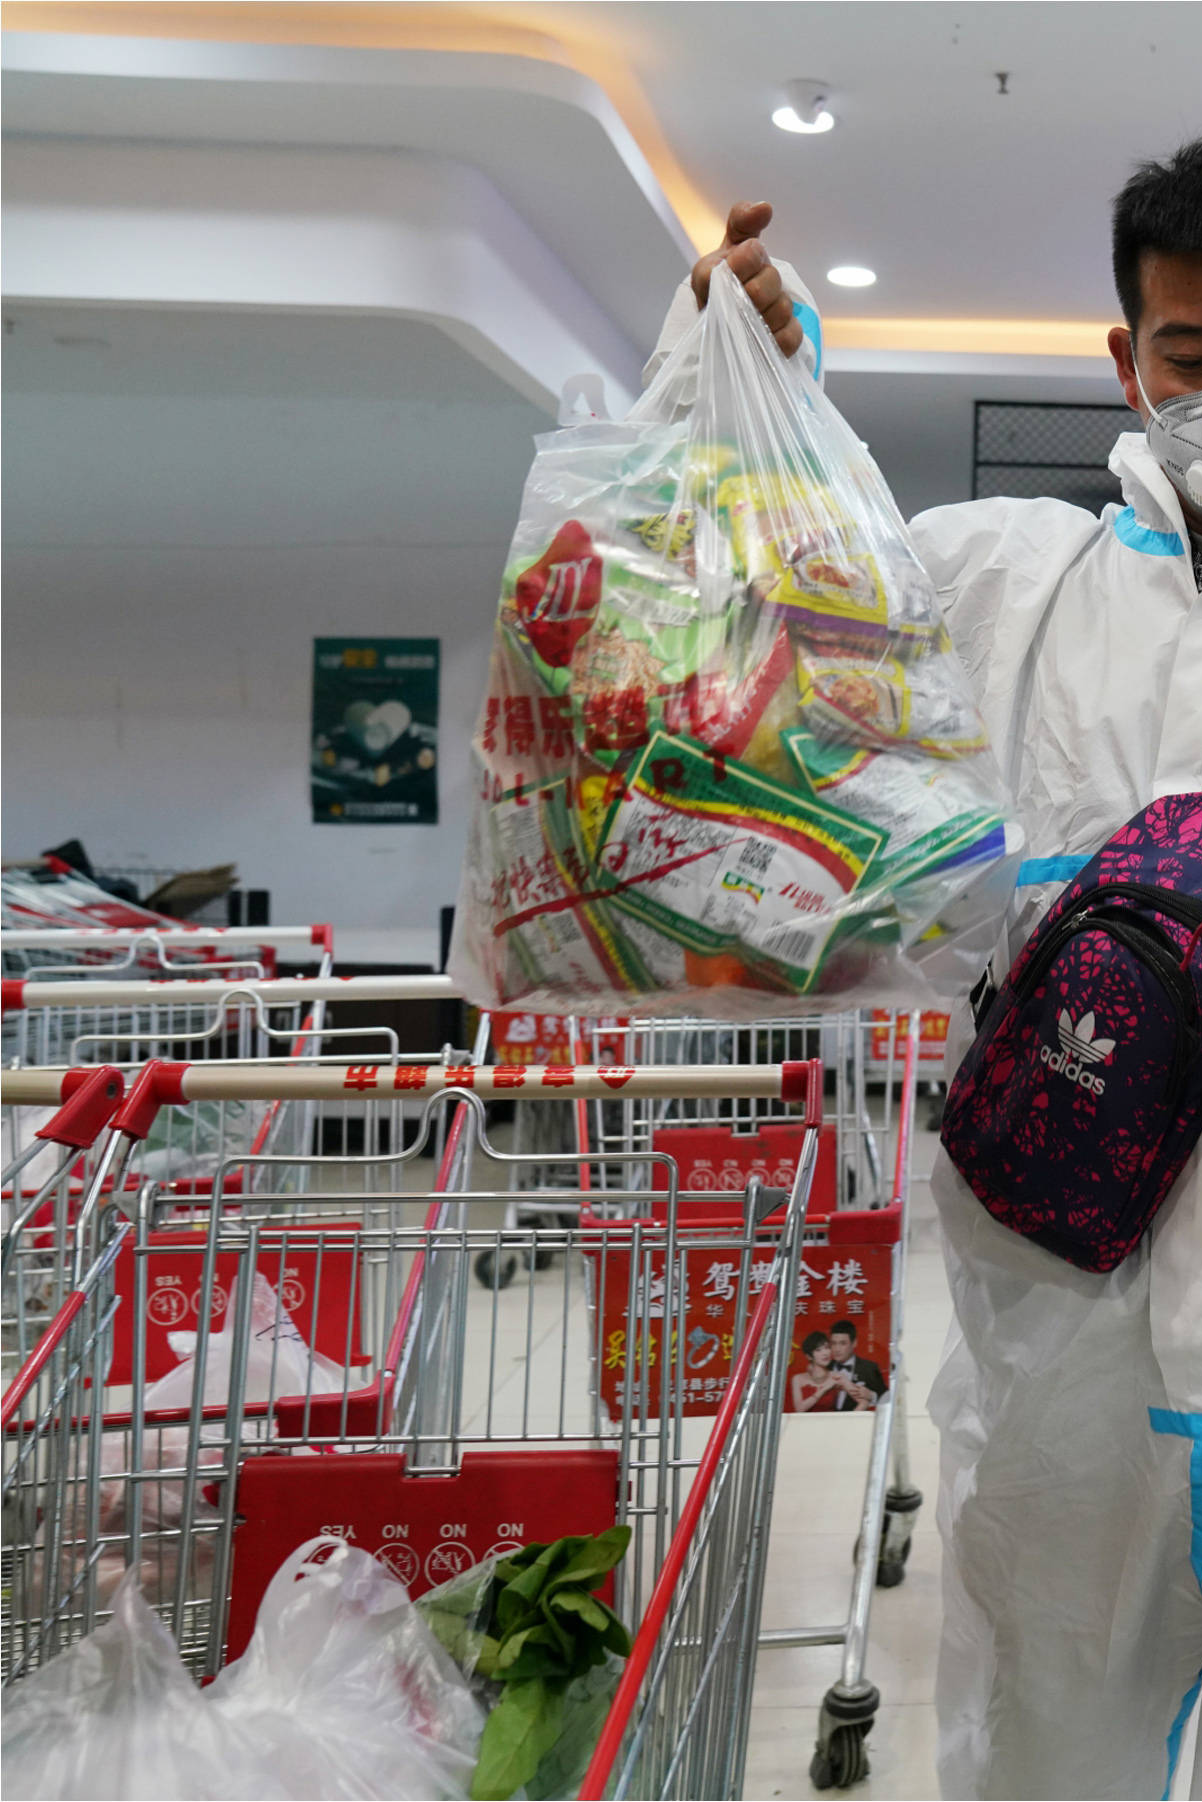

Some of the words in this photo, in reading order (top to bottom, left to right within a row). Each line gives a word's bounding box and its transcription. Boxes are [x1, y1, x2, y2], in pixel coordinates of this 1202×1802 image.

[1040, 1044, 1107, 1096] adidas
[155, 1276, 182, 1287] YES
[319, 1524, 357, 1540] YES
[382, 1524, 409, 1539] NO
[440, 1523, 467, 1539] NO
[497, 1522, 525, 1538] NO
